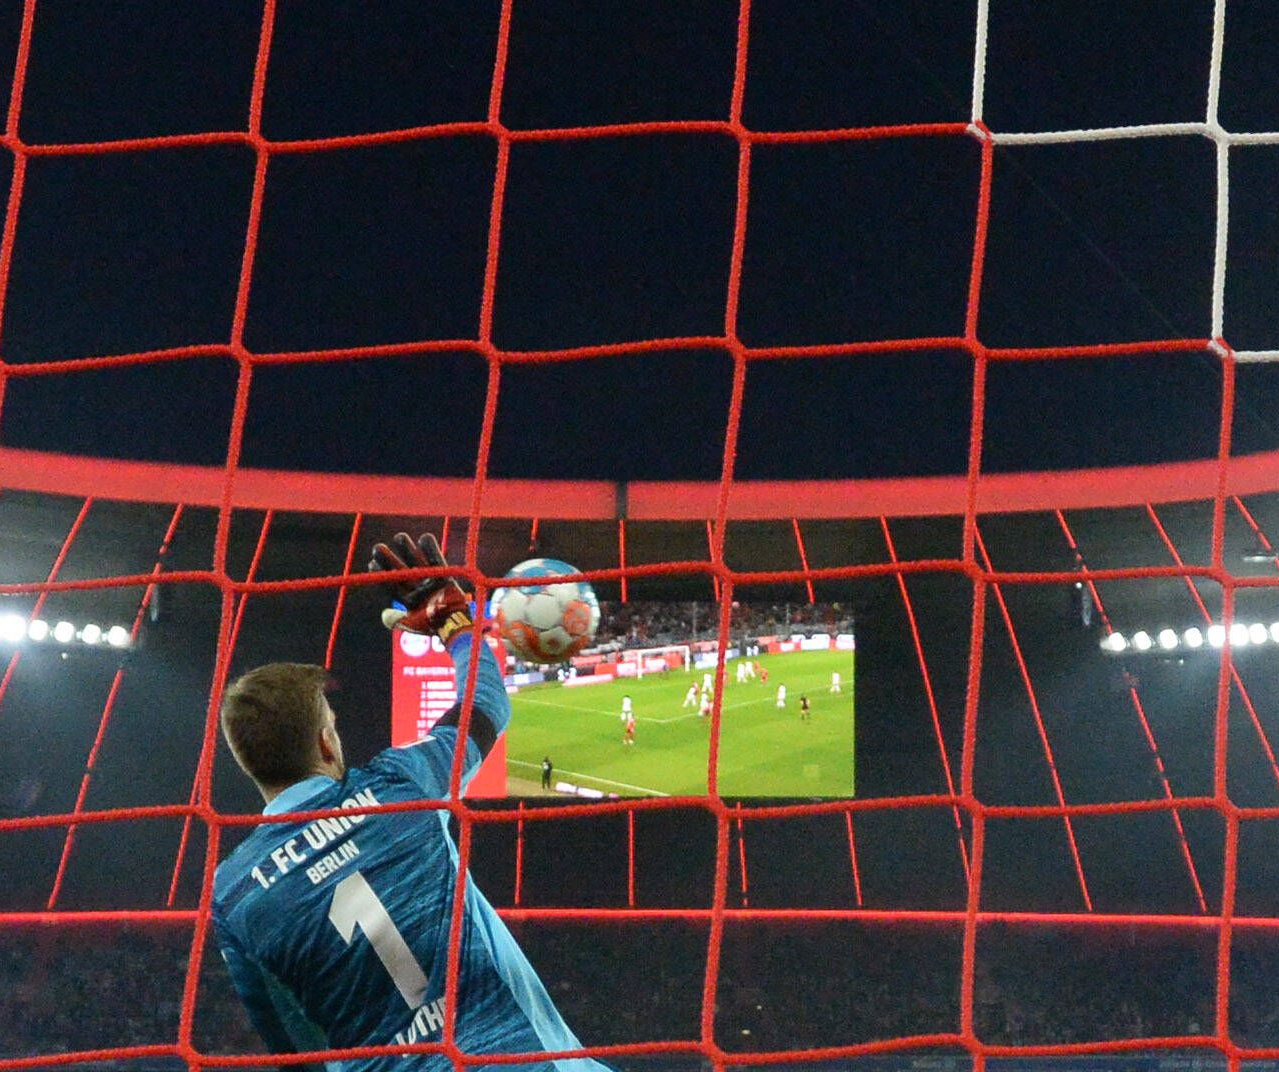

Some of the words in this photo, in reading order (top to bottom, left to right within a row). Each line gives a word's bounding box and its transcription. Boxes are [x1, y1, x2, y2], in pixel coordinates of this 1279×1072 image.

[251, 865, 276, 890] 1.
[270, 839, 307, 875] FC
[302, 788, 381, 850] UNION
[305, 839, 360, 885] BERLIN
[328, 871, 429, 1010] 1
